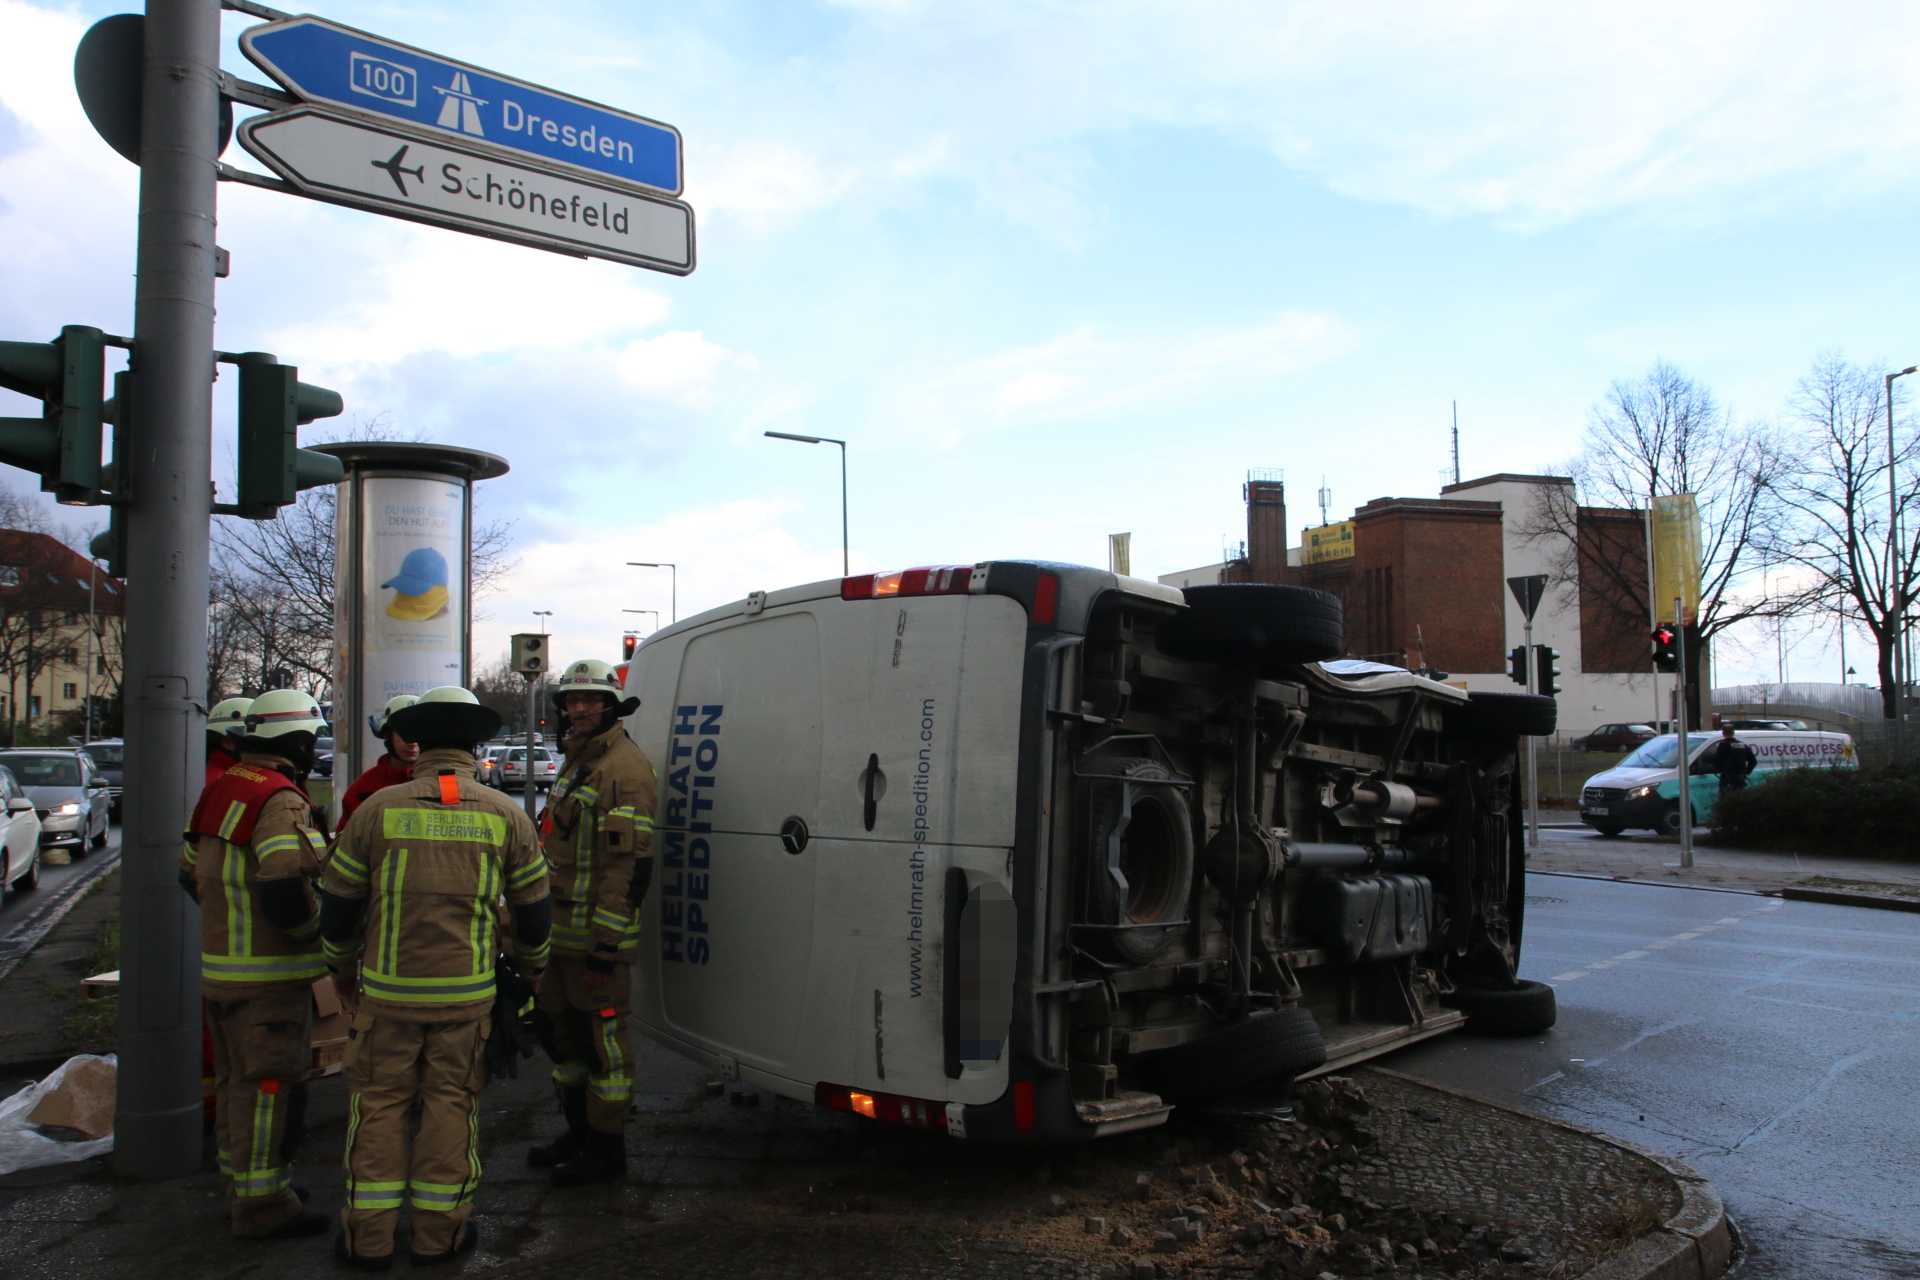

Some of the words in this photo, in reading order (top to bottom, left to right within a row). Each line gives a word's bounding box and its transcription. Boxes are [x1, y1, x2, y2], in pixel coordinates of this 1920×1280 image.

[363, 63, 405, 95] 100
[503, 99, 634, 164] Dresden
[440, 163, 629, 235] Schönefeld
[385, 505, 399, 515] DU
[402, 506, 426, 516] HAST
[389, 516, 408, 526] DEN
[411, 517, 429, 527] HUT
[1750, 743, 1844, 757] Durstexpress
[426, 824, 494, 841] FEUERWEHR
[427, 813, 475, 825] BERLINER
[662, 705, 698, 963] HELMRATH
[686, 704, 724, 966] SPEDITION
[907, 698, 935, 999] www.helmrath-spedition.com
